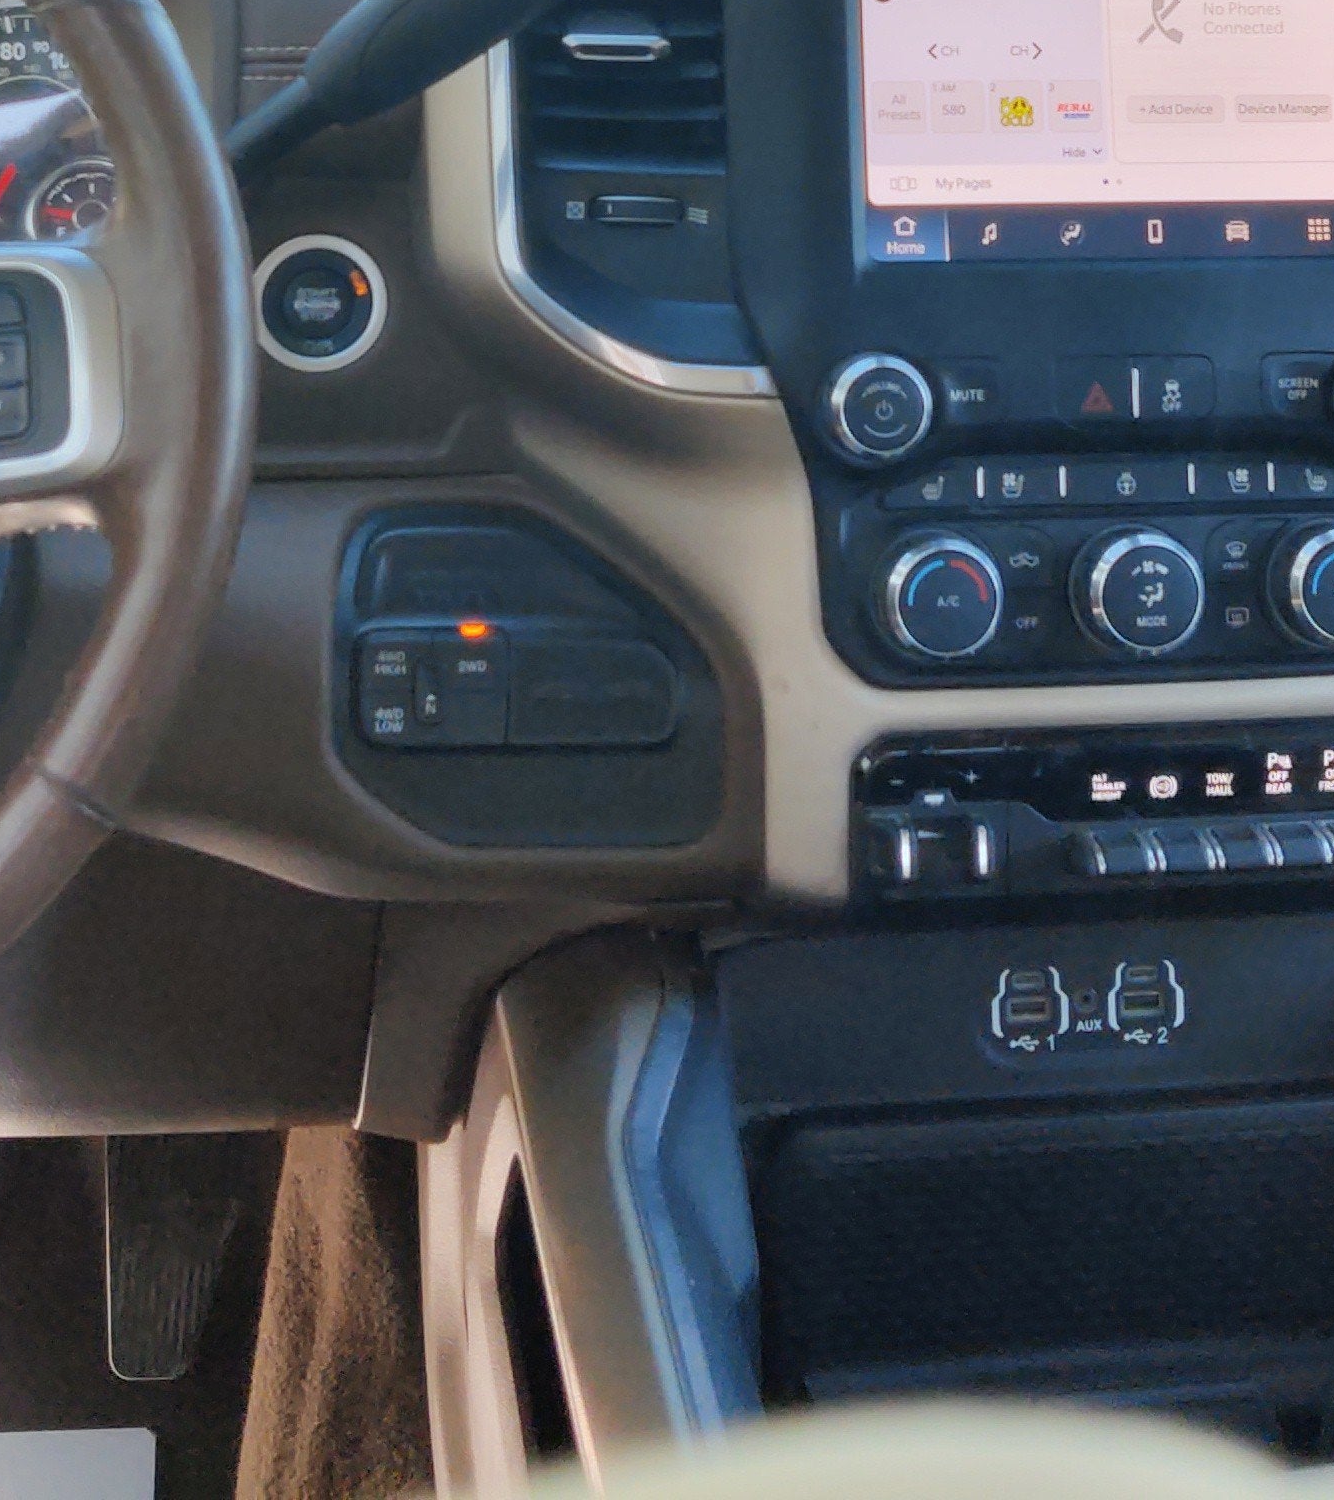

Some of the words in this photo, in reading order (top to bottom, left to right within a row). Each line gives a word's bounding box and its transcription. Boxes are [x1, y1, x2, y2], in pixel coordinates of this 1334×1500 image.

[1203, 2, 1224, 16] No
[1228, 2, 1282, 16] Phones
[1203, 21, 1284, 35] Connected
[0, 42, 26, 61] 80
[940, 46, 959, 57] CH
[1010, 46, 1029, 57] CH
[891, 94, 907, 105] All
[878, 109, 921, 121] Presets
[1148, 104, 1173, 116] Add
[1175, 104, 1213, 116] Device
[1238, 103, 1276, 116] Device
[1278, 104, 1329, 118] Manager
[1062, 147, 1086, 158] Hide
[935, 177, 954, 191] My
[956, 177, 992, 192] Pages
[886, 240, 925, 256] Home
[950, 389, 985, 402] MUTE
[1268, 770, 1289, 782] OFF
[1075, 1019, 1103, 1033] AUX
[1046, 1033, 1056, 1051] 1
[1156, 1026, 1169, 1044] 2
